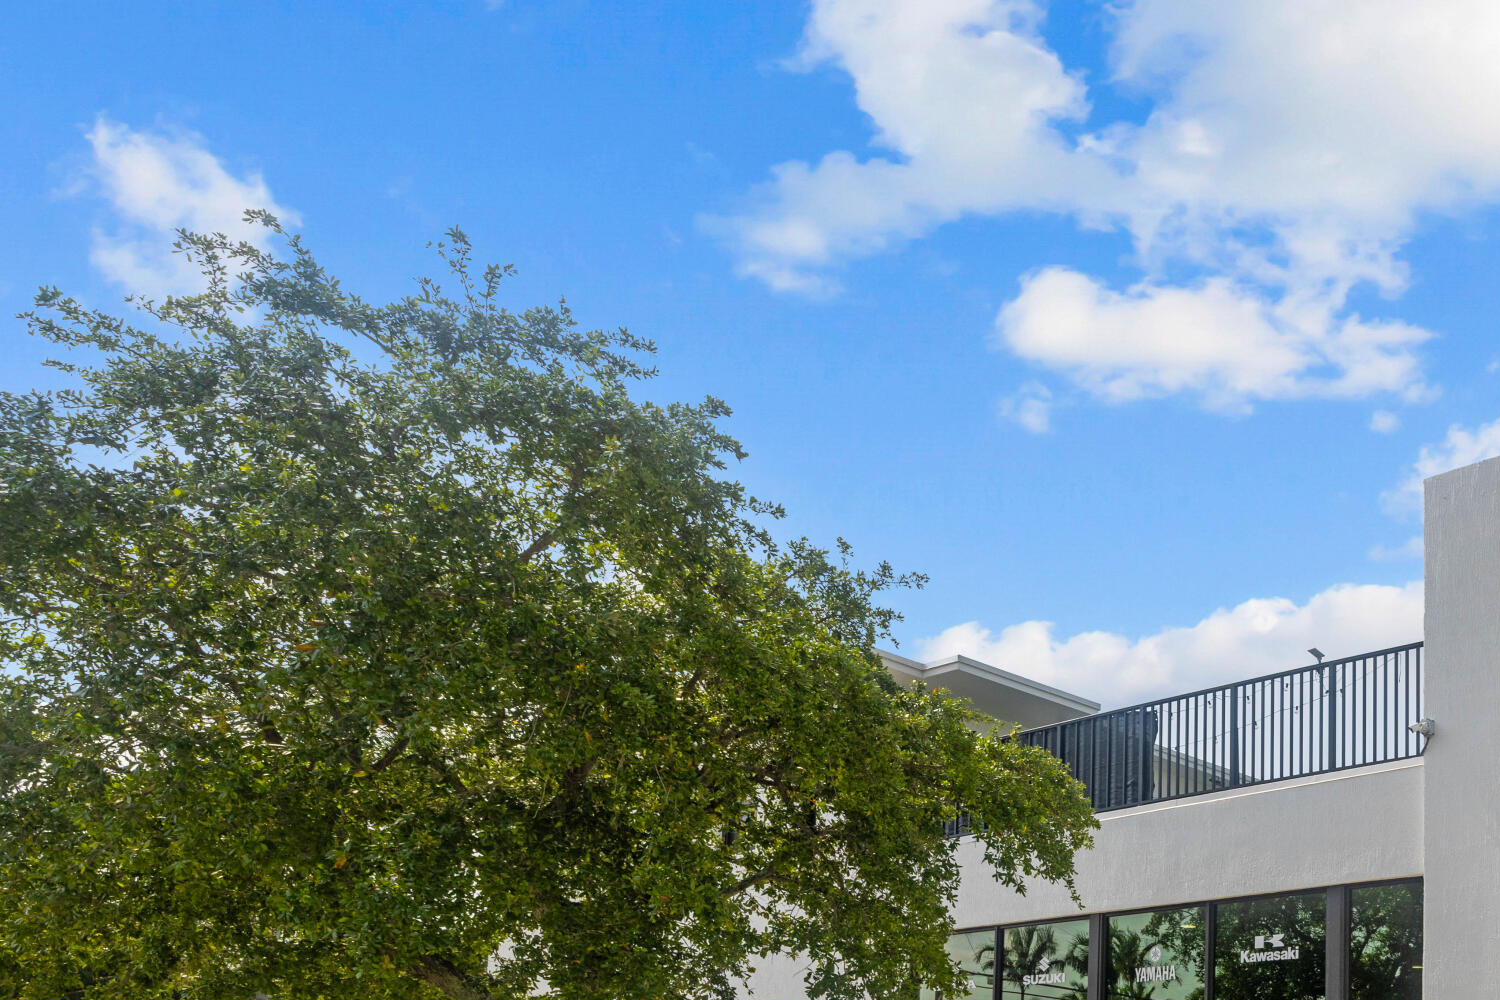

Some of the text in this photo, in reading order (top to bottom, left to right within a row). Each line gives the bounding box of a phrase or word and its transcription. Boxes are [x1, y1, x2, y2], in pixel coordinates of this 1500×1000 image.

[1240, 946, 1299, 963] Kawasaki
[1022, 973, 1066, 986] SUZUKI
[1134, 965, 1176, 982] YAMAHA
